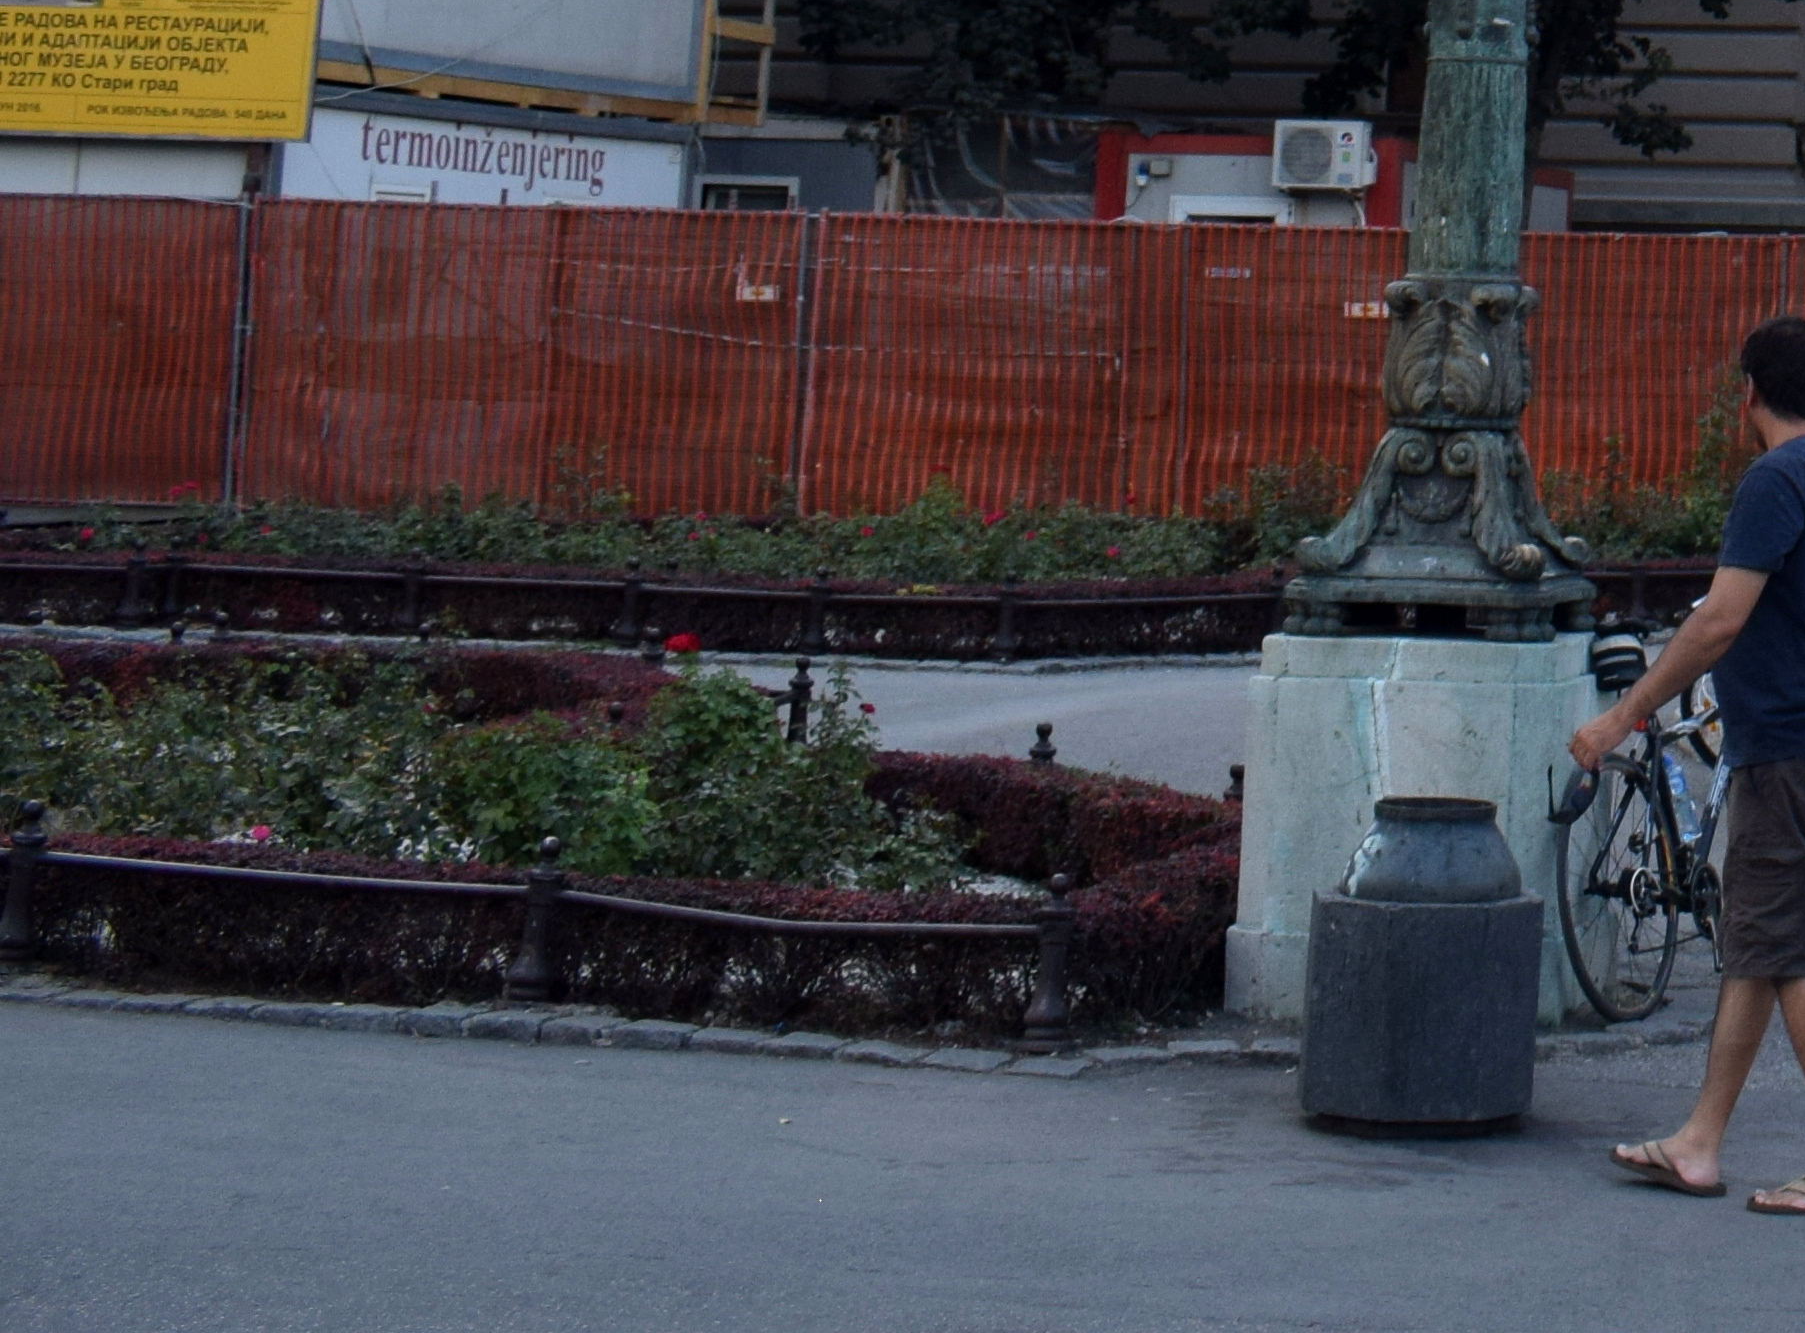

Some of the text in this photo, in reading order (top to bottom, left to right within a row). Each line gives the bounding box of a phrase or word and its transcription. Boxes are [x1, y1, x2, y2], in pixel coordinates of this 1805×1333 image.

[14, 13, 88, 29] РАДОВА
[94, 14, 118, 30] НА
[124, 15, 269, 35] РЕСТАУРАЦИЈИ,
[22, 33, 34, 47] И
[40, 33, 161, 50] АДАПТАЦИЈИ
[167, 36, 249, 53] ОБЈЕКТА
[38, 53, 108, 69] МУЗЕЈА
[114, 55, 125, 70] У
[130, 55, 229, 75] БЕОГРАДУ,
[7, 72, 46, 87] 2277
[51, 73, 76, 88] КО
[81, 74, 134, 93] Стари
[139, 78, 178, 93] град
[361, 117, 606, 197] termoinženjering
